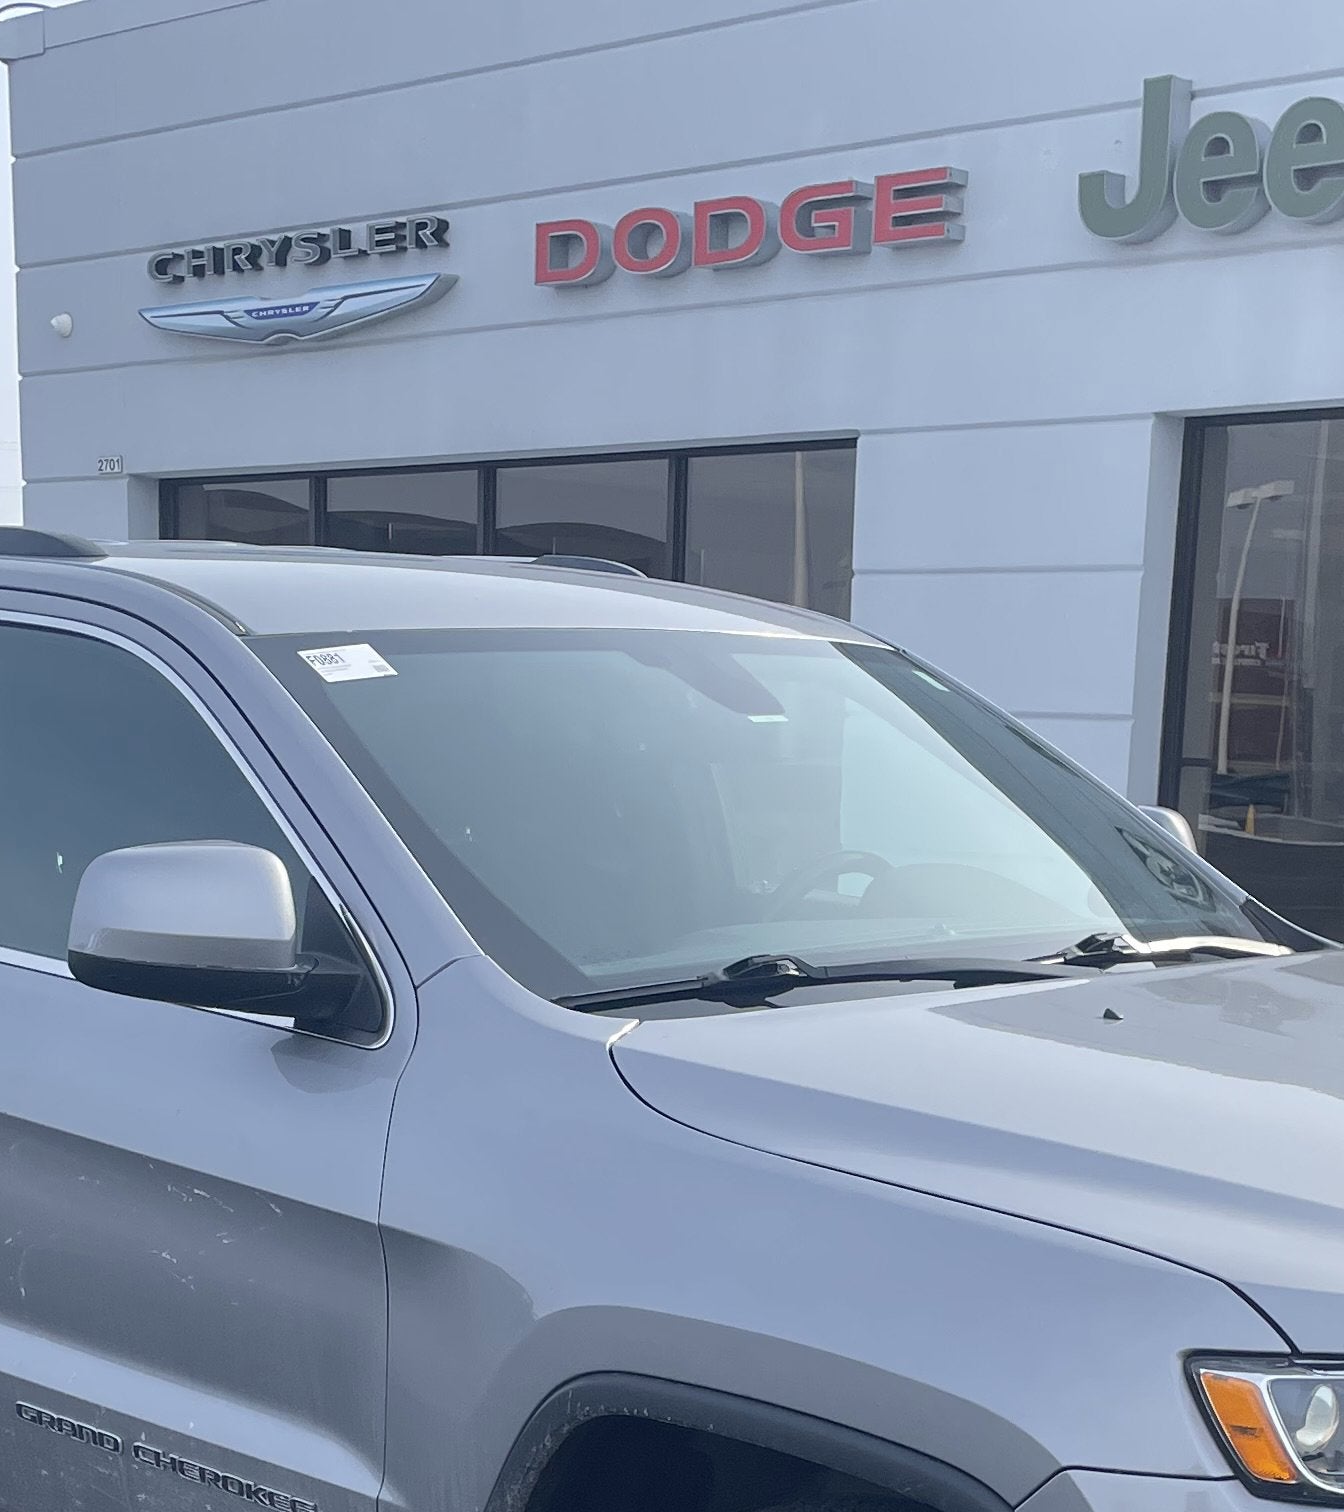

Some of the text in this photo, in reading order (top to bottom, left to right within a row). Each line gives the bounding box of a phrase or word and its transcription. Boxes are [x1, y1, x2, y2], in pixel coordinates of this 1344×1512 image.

[147, 214, 450, 284] CHRYSLER
[535, 166, 968, 287] DODGE
[251, 305, 310, 318] CHRYSLER
[97, 458, 120, 472] 2701
[15, 1400, 123, 1455] GRAND
